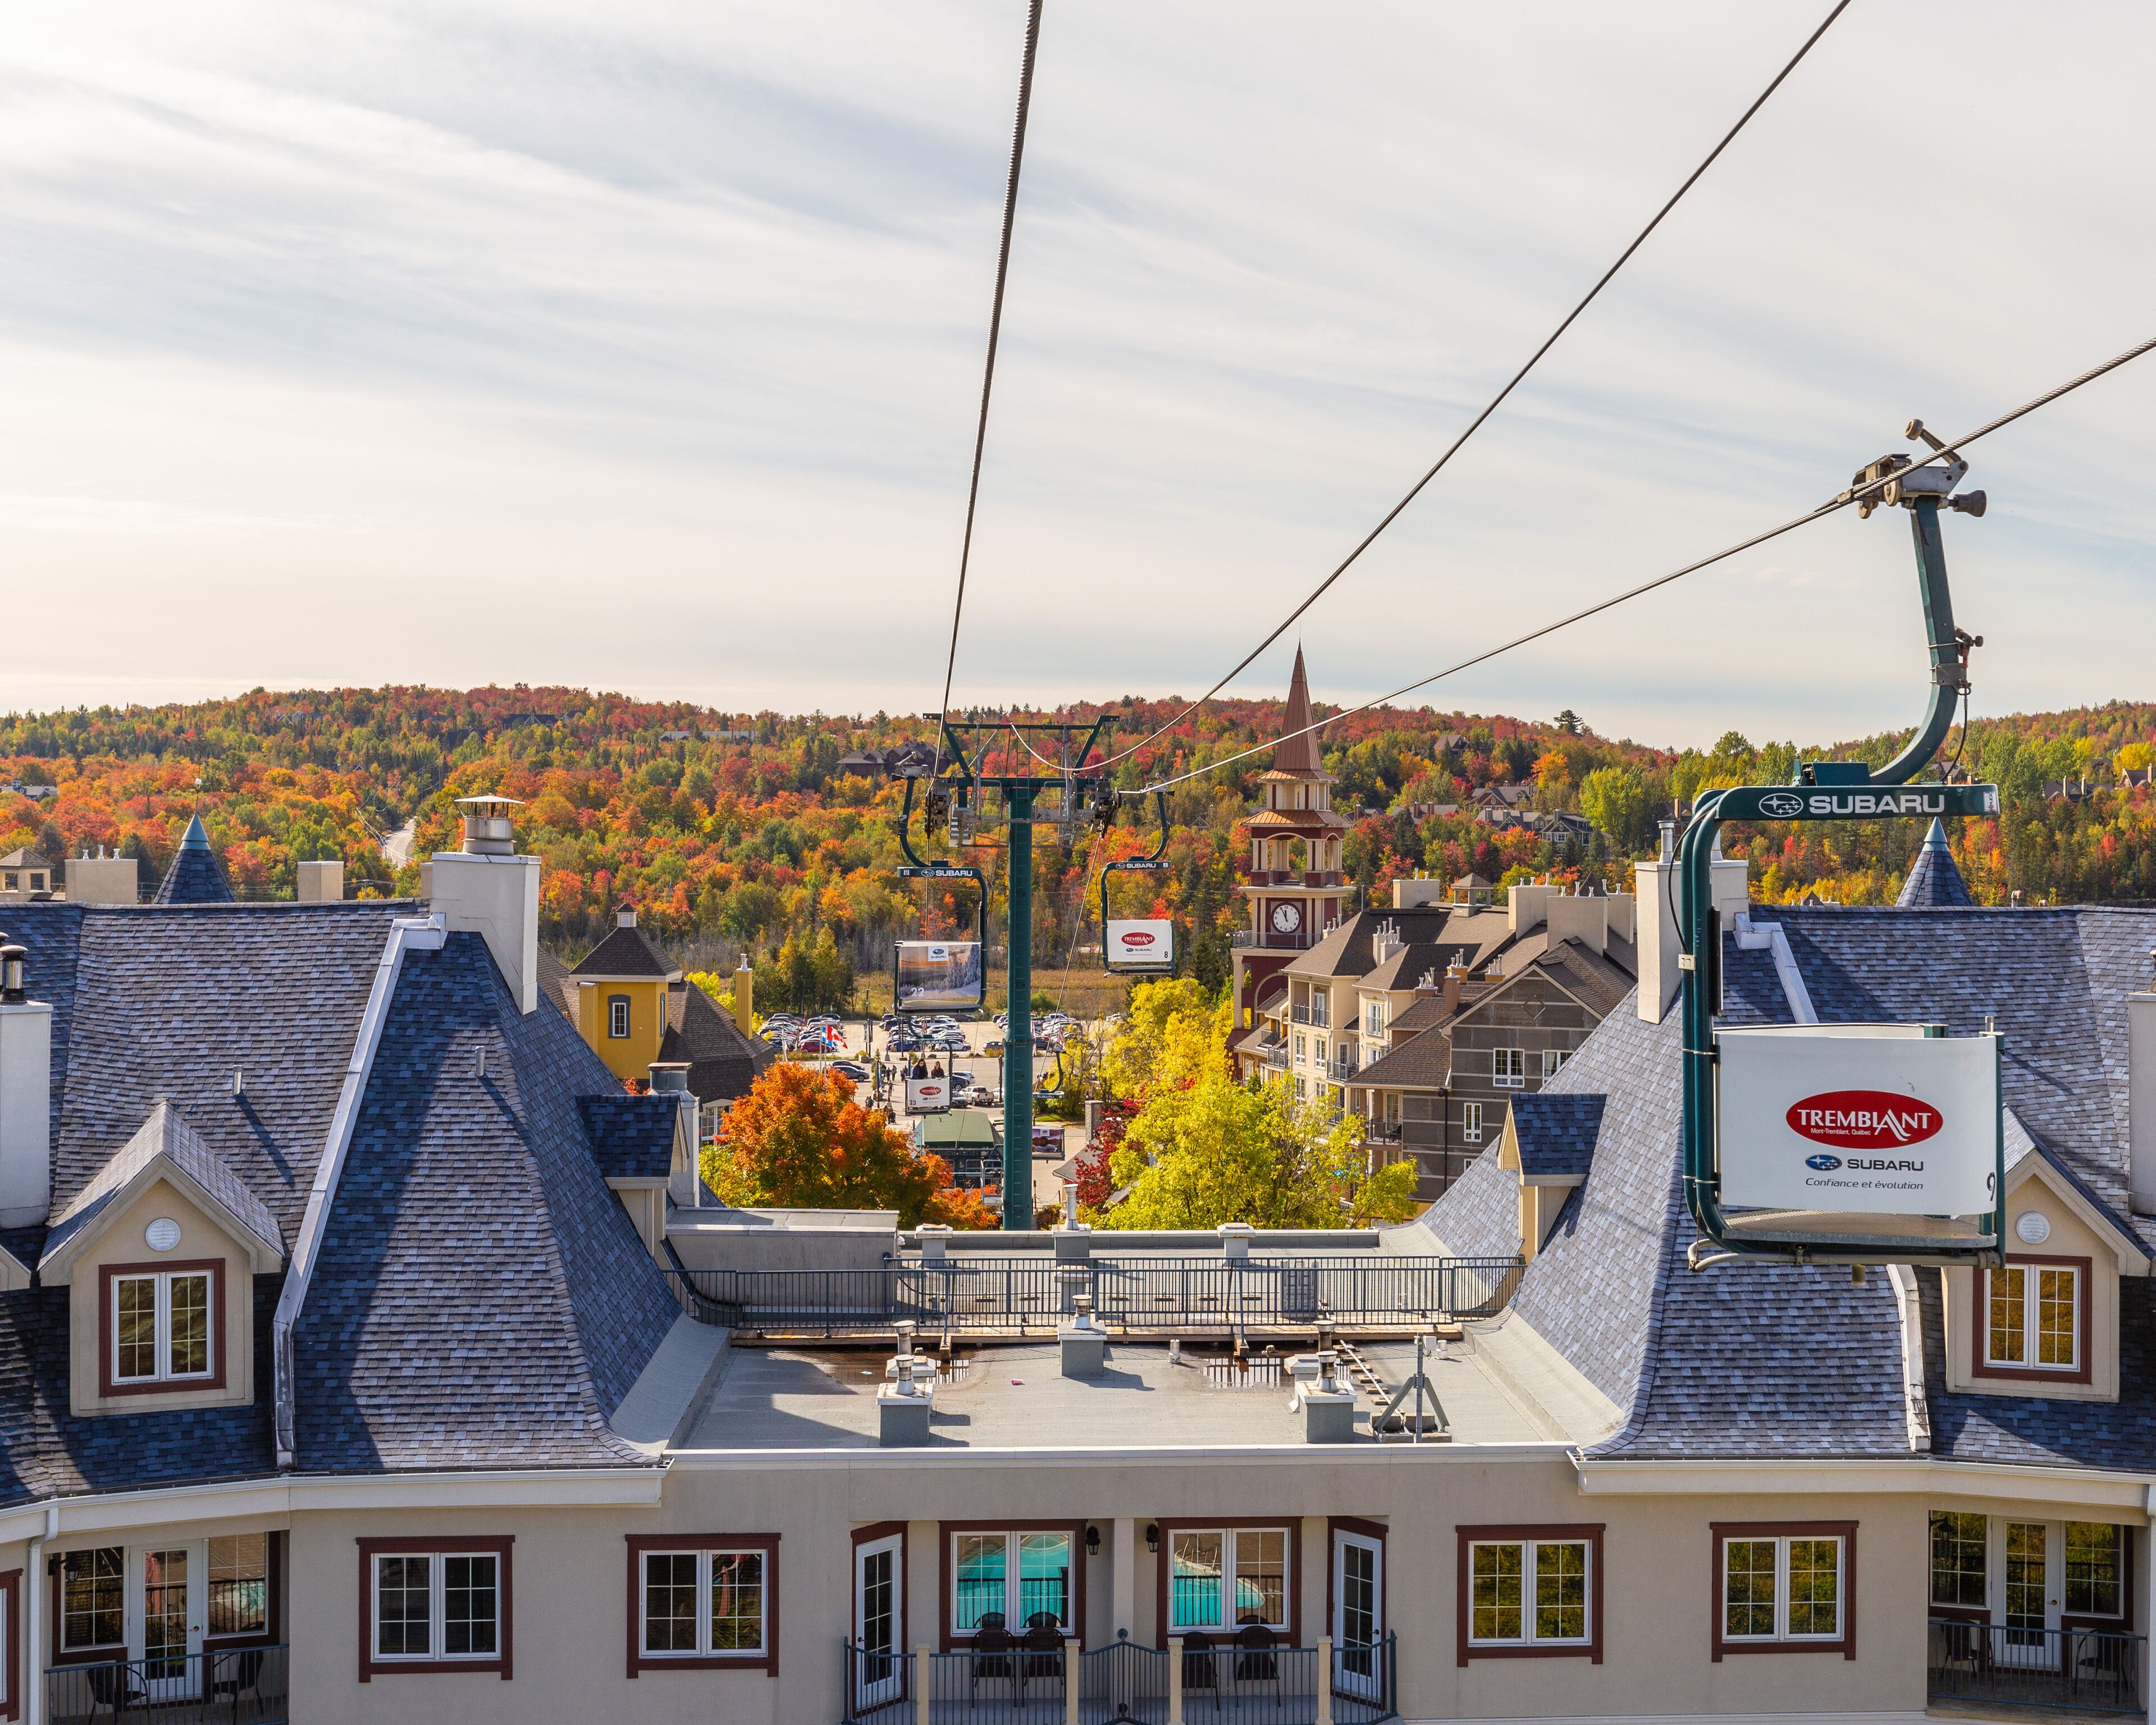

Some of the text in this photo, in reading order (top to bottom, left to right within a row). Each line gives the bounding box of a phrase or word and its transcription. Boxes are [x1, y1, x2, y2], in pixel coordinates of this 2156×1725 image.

[1809, 795, 1945, 814] SUBARU
[1989, 794, 1993, 805] 9
[1124, 935, 1153, 944] TREMBLANT
[911, 987, 925, 997] 22
[1797, 1108, 1931, 1142] TREMBLANT
[1847, 1158, 1924, 1171] SUBARU
[1806, 1178, 1858, 1188] Confiance
[1875, 1180, 1924, 1190] évolution
[1986, 1171, 1995, 1202] 9
